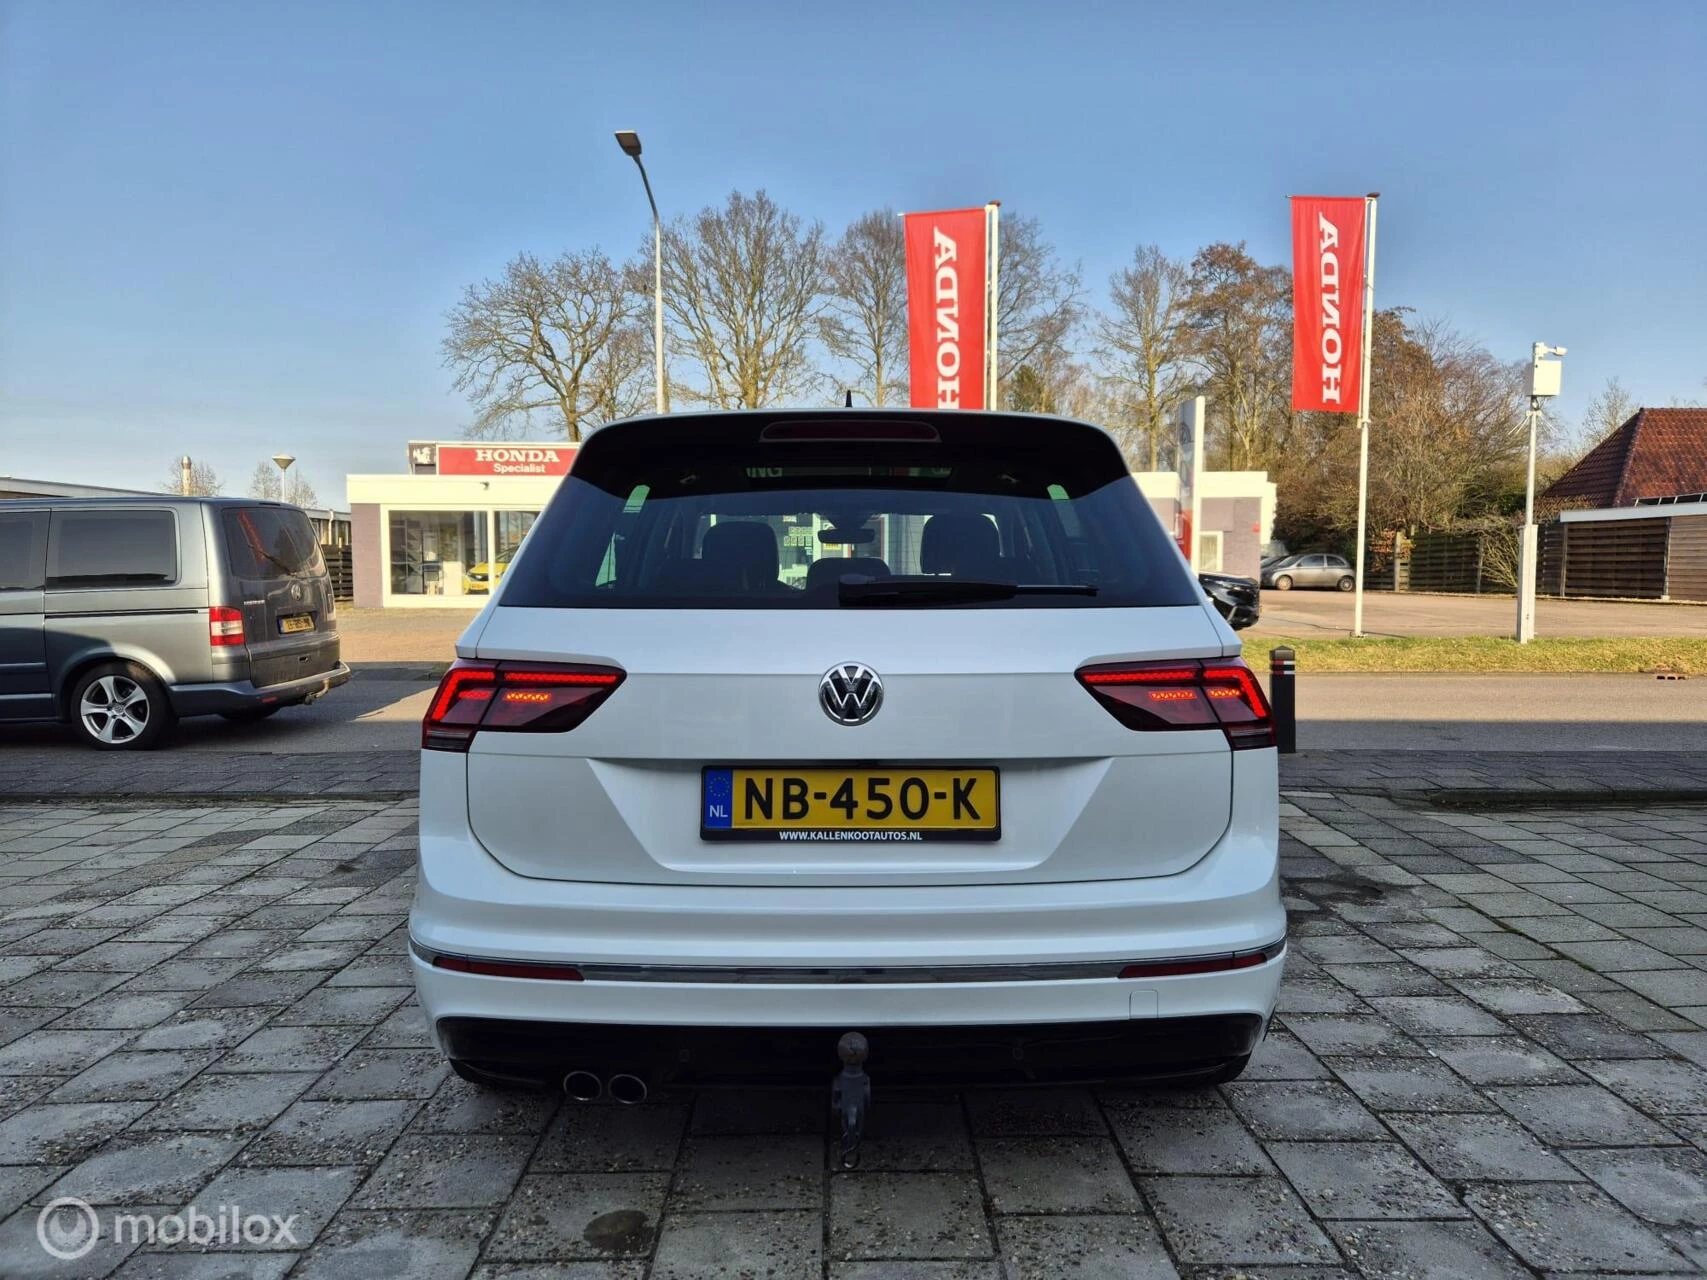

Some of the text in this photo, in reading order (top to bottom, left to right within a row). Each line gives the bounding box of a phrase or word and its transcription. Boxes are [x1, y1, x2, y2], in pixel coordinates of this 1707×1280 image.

[475, 449, 560, 463] HONDA
[493, 463, 546, 474] Specialist
[744, 777, 981, 820] NB-450-K
[709, 804, 728, 818] NL
[779, 831, 923, 842] WWW.KALLENKOOTAUTOS.NL
